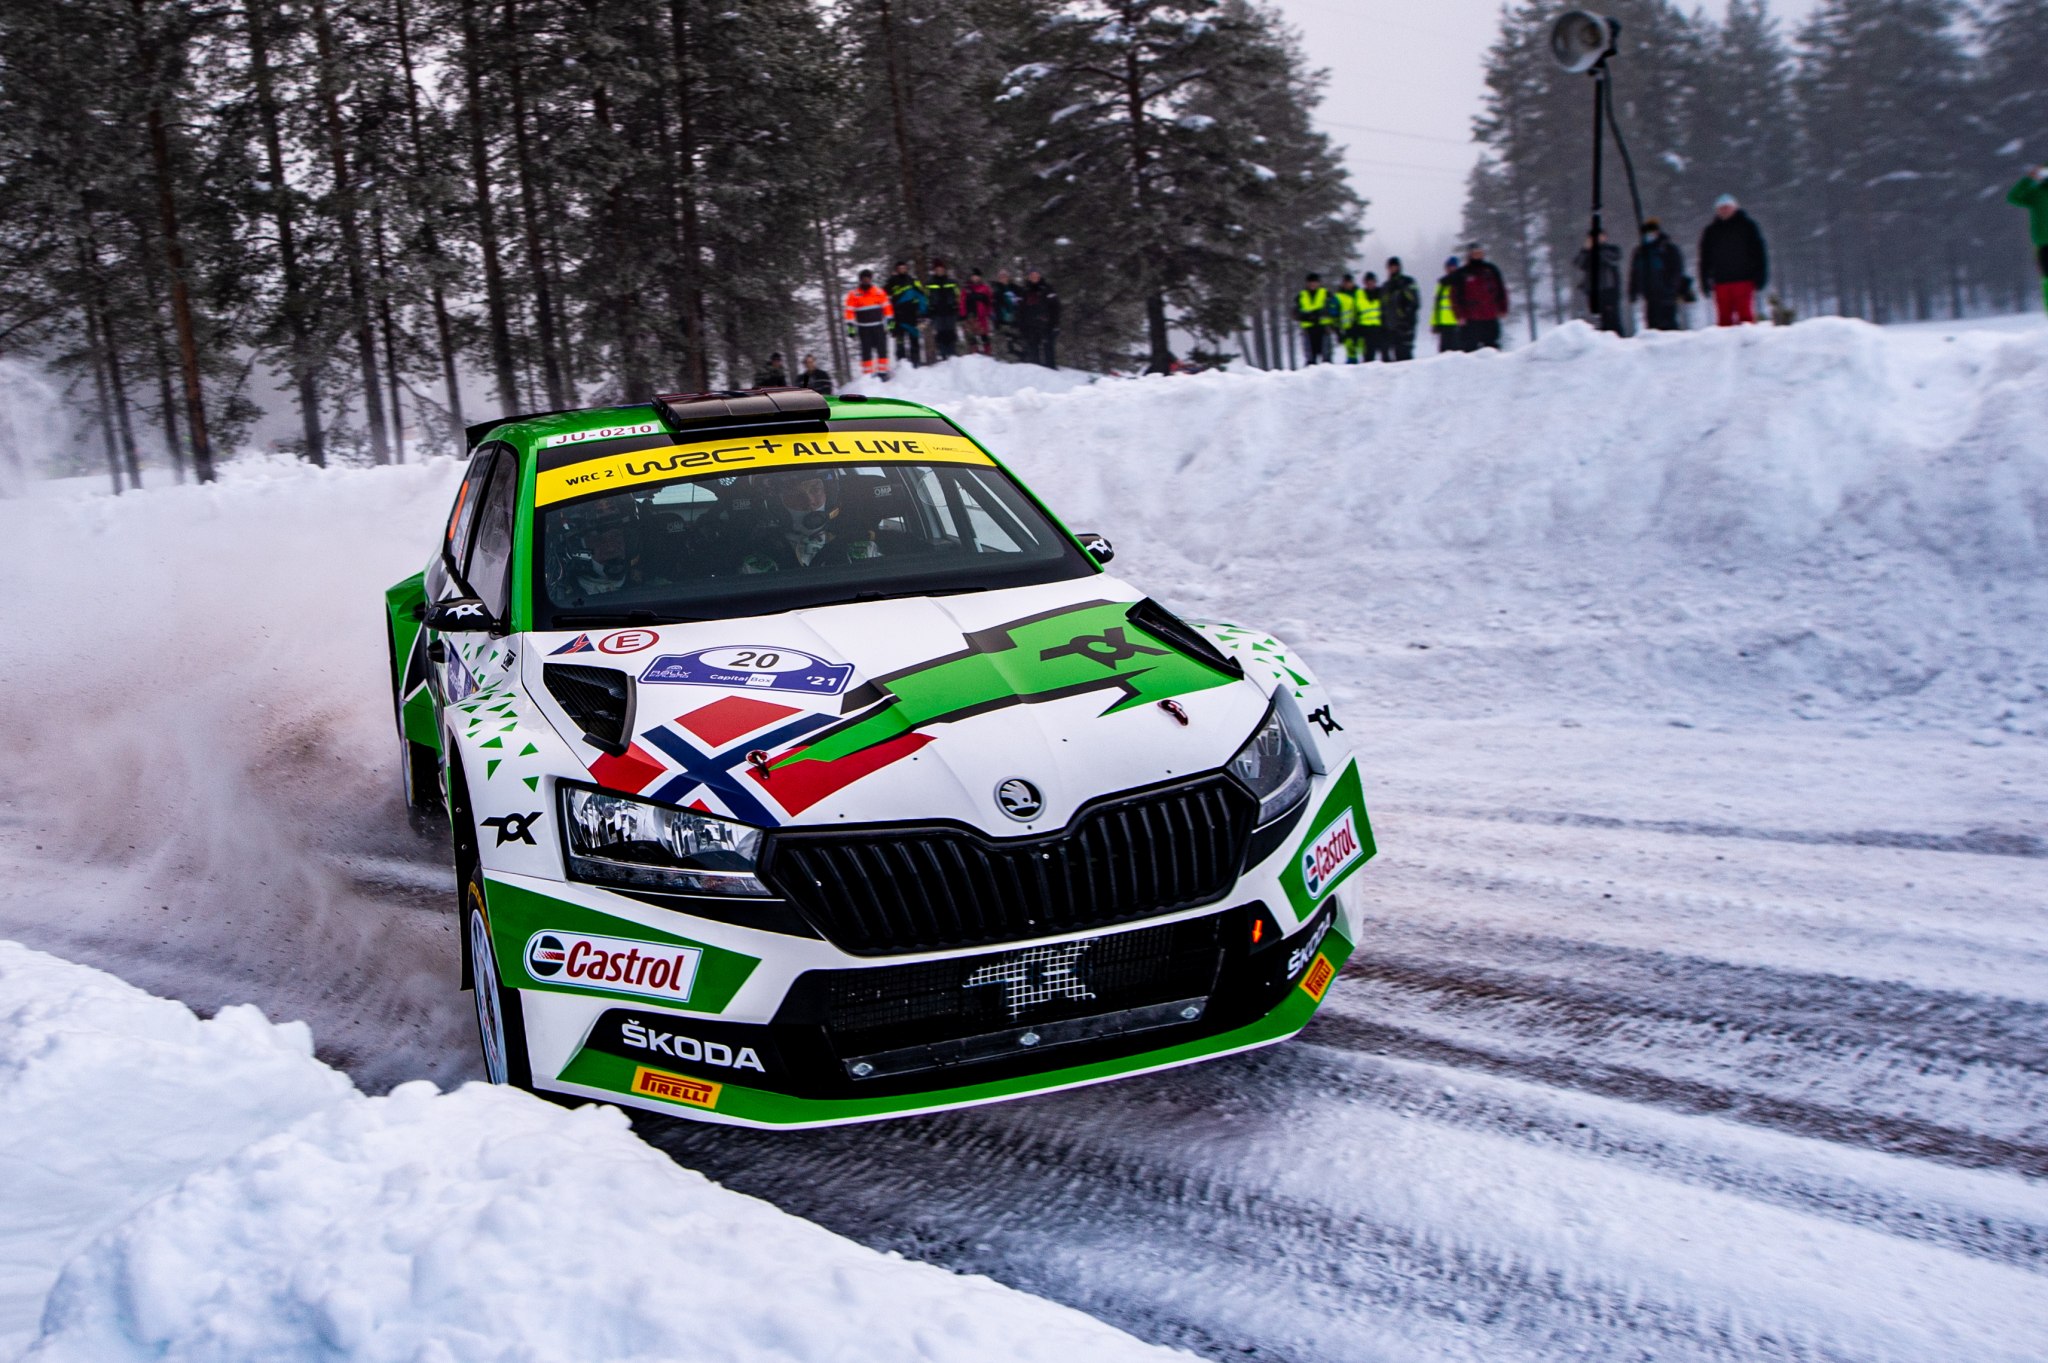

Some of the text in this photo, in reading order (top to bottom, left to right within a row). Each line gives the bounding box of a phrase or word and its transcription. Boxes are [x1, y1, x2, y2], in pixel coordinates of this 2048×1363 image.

[555, 424, 652, 445] JU-0210
[794, 441, 850, 456] ALL
[855, 440, 924, 454] LIVE
[566, 469, 614, 486] WRC 2
[615, 633, 641, 649] E
[728, 651, 780, 669] 20
[1315, 818, 1357, 882] Castrol
[566, 941, 685, 991] Castrol
[1304, 957, 1332, 997] PIRELLI
[621, 1018, 766, 1073] ŠKODA
[639, 1071, 714, 1104] PIRELLI
